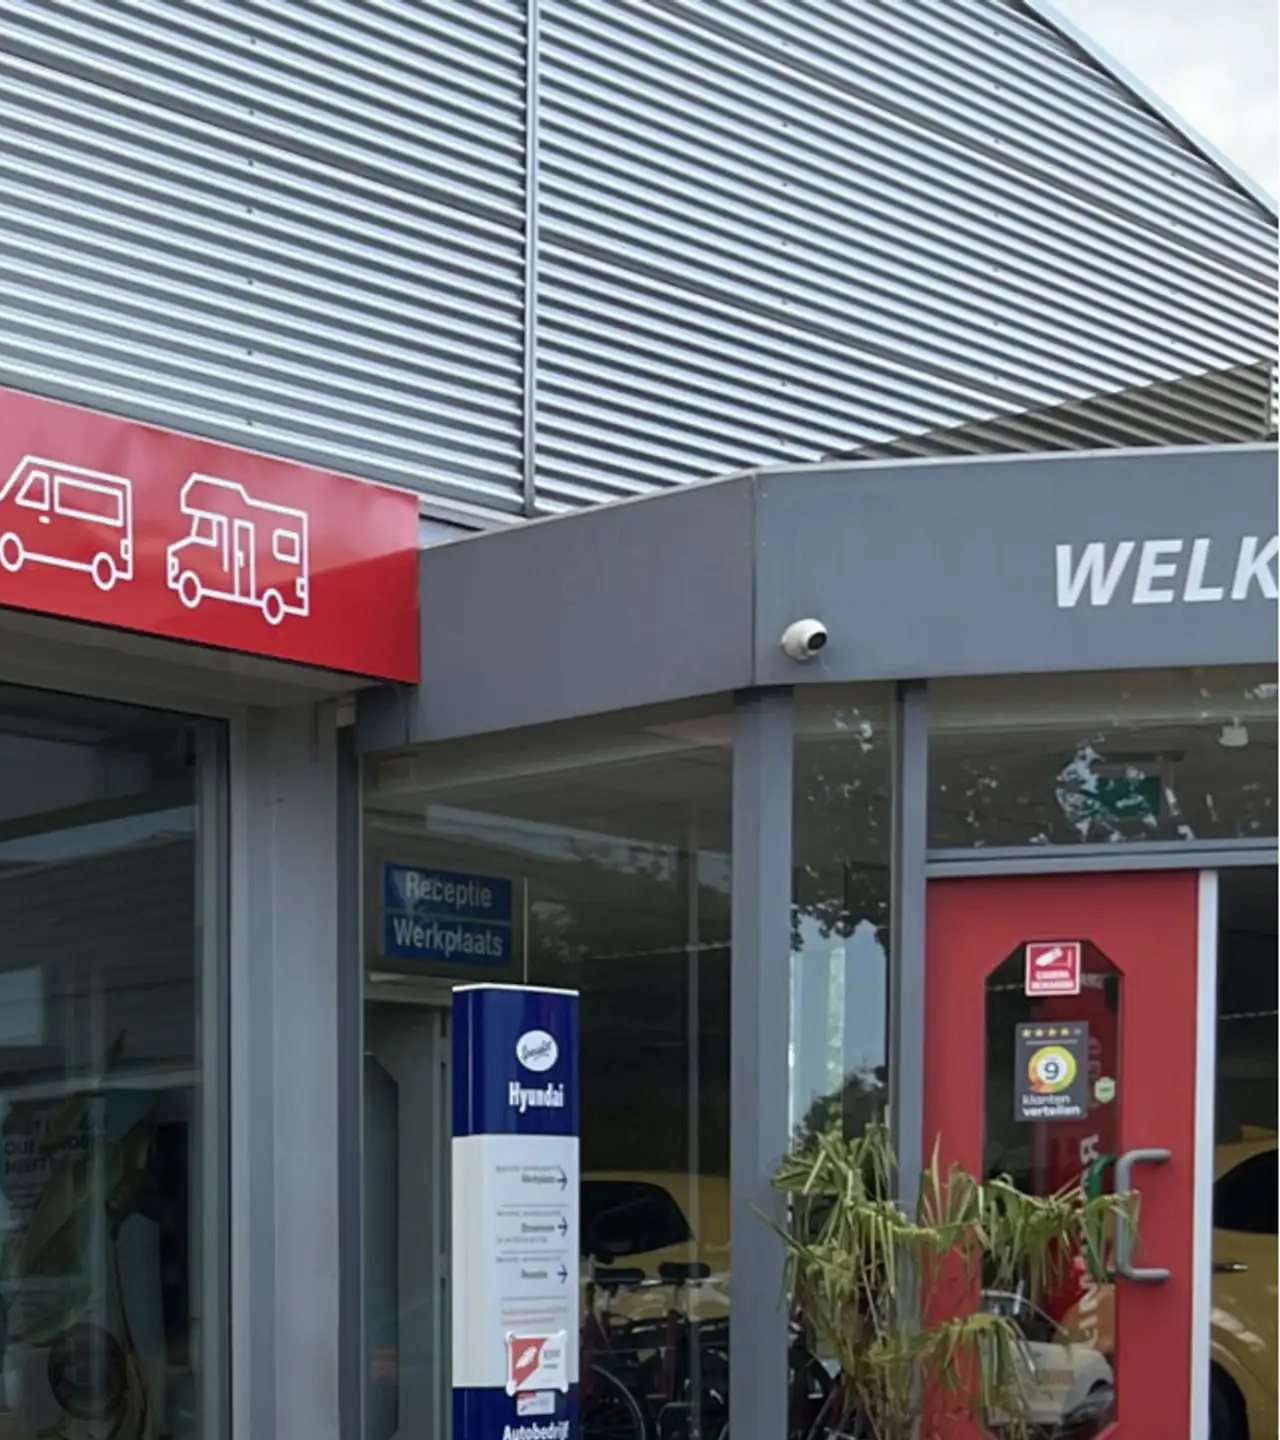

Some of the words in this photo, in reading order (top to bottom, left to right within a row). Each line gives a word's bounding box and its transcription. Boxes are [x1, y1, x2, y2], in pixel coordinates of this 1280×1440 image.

[1055, 535, 1278, 608] WELK
[404, 871, 493, 909] Receptie
[393, 915, 504, 958] Werkplaats
[1044, 1062, 1060, 1080] 9
[509, 1081, 564, 1113] Hyundai
[1022, 1093, 1071, 1105] klanten
[1022, 1105, 1081, 1117] vertellen
